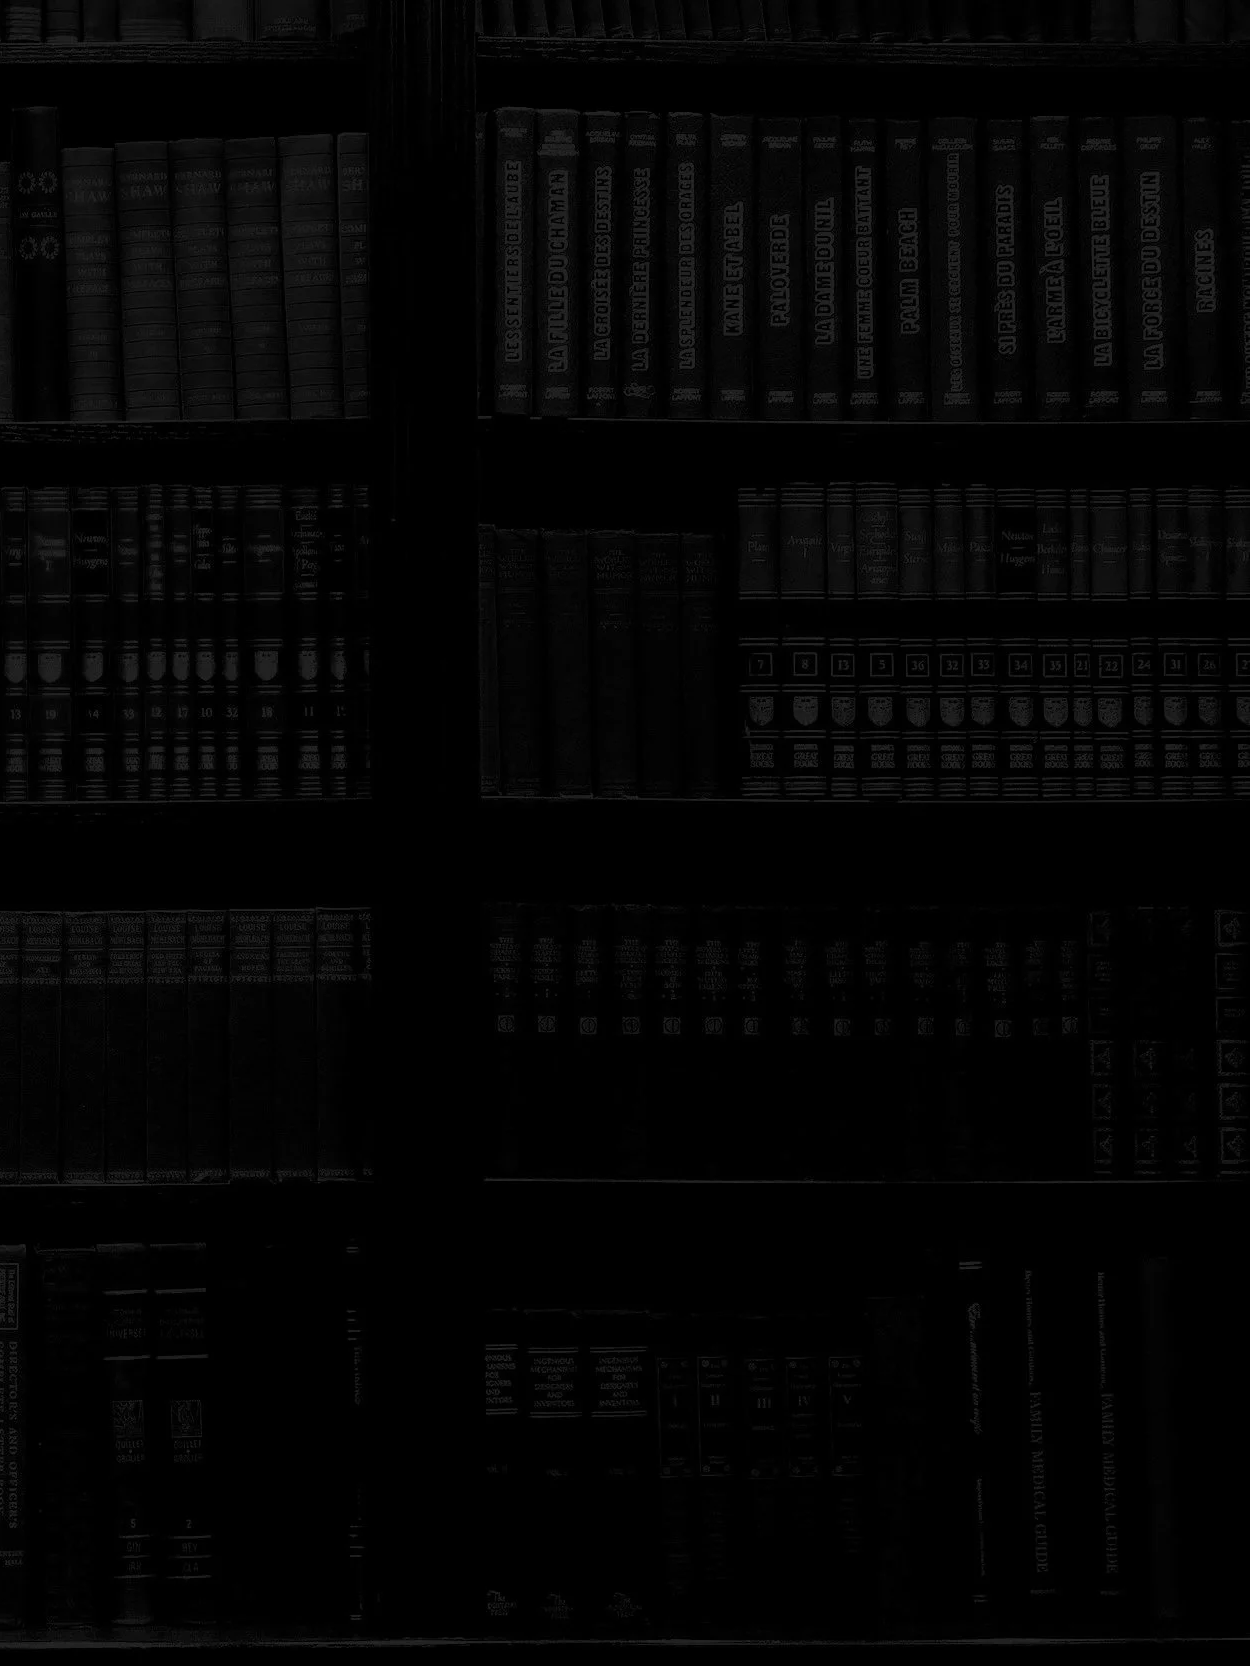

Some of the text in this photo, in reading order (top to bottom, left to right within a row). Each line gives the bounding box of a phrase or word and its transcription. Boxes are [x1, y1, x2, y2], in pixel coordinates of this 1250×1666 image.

[594, 165, 612, 234] DESTINS
[632, 167, 650, 259] PRINCESSE
[505, 219, 523, 245] DE
[996, 184, 1015, 257] PARADIS
[594, 235, 612, 268] DES
[678, 161, 695, 370] LA SPLENDEUR DES ORAGES
[548, 169, 569, 372] LA FILLE DU CHAMAN
[723, 201, 743, 336] KANE ET ABEL
[770, 213, 790, 327] PALOVERDE
[814, 197, 834, 345] LA DAME DU NIL
[855, 166, 874, 379] UNE FEMME COEUR BATTANT
[898, 208, 920, 334] PALM BEACH
[997, 260, 1015, 288] DU
[1090, 174, 1113, 367] LA BICYCLETTE BLEUE
[1140, 171, 1164, 370] LA FORCE DU DESTIN
[1195, 228, 1216, 312] RACINES
[505, 246, 523, 328] SENTIERS
[505, 328, 523, 361] LES
[594, 337, 611, 361] LA
[632, 347, 650, 371] LA
[998, 334, 1016, 355] SI
[757, 659, 765, 670] 7
[801, 659, 810, 670] 8
[837, 659, 850, 671] 13
[878, 659, 886, 670] 5
[910, 660, 925, 671] 36
[945, 660, 959, 671] 32
[977, 660, 991, 671] 33
[1014, 660, 1029, 671] 34
[1049, 660, 1062, 671] 35
[1076, 660, 1089, 671] 21
[1105, 661, 1119, 672] 22
[1137, 659, 1151, 670] 24
[1170, 659, 1181, 670] 31
[8, 1427, 19, 1456] AND
[1029, 1391, 1050, 1575] FAMILY MEDICAL GUIDE
[1101, 1393, 1120, 1575] FAMILY MEDICAL GUIDE
